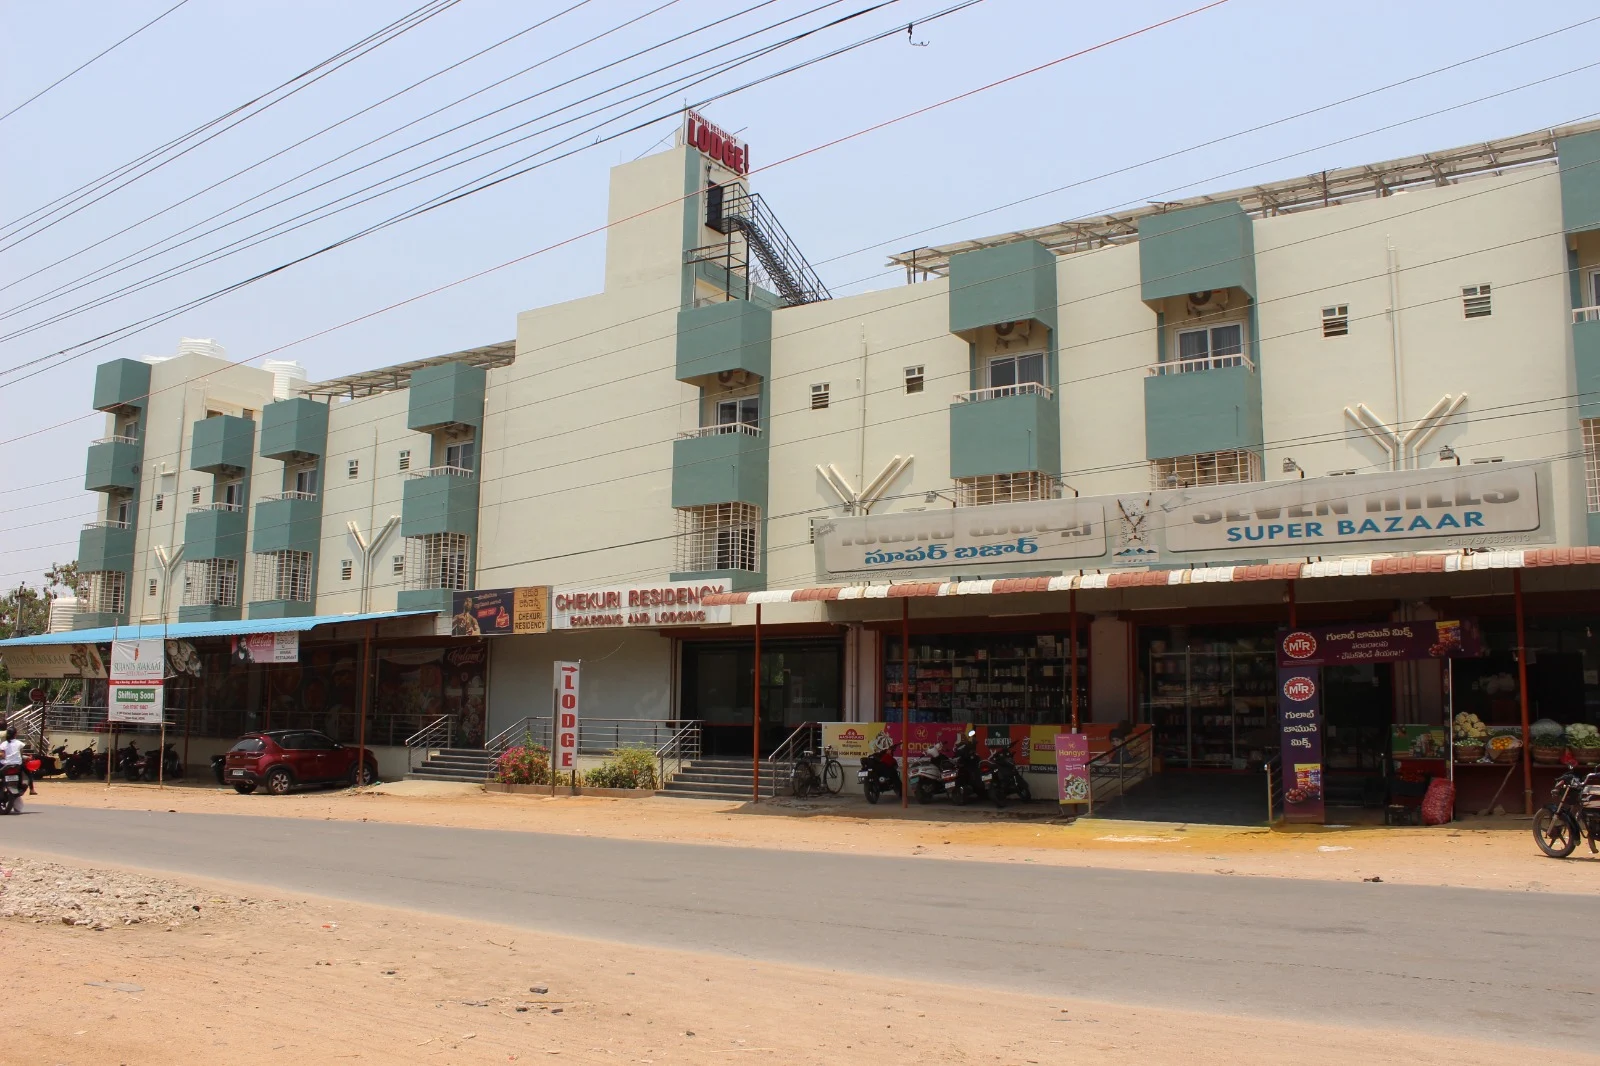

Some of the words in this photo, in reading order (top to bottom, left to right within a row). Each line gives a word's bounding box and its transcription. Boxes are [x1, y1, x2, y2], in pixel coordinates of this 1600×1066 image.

[687, 117, 743, 174] LODGE
[1226, 521, 1325, 542] SUPER
[1337, 511, 1486, 536] BAZAAR
[864, 543, 948, 565] సూపర్
[954, 537, 1039, 559] బజార్
[555, 591, 622, 611] CHEKURI
[518, 612, 543, 621] CHEKURI
[569, 613, 624, 627] BOARDING
[627, 611, 651, 624] AND
[654, 609, 706, 624] LODGING
[514, 621, 546, 630] RESIDENCY
[1289, 638, 1311, 652] MTR
[117, 691, 139, 701] Shifting
[139, 691, 155, 700] Soon
[1289, 682, 1310, 695] MTR
[560, 675, 576, 767] LODGE
[1058, 749, 1086, 758] Hangyo
